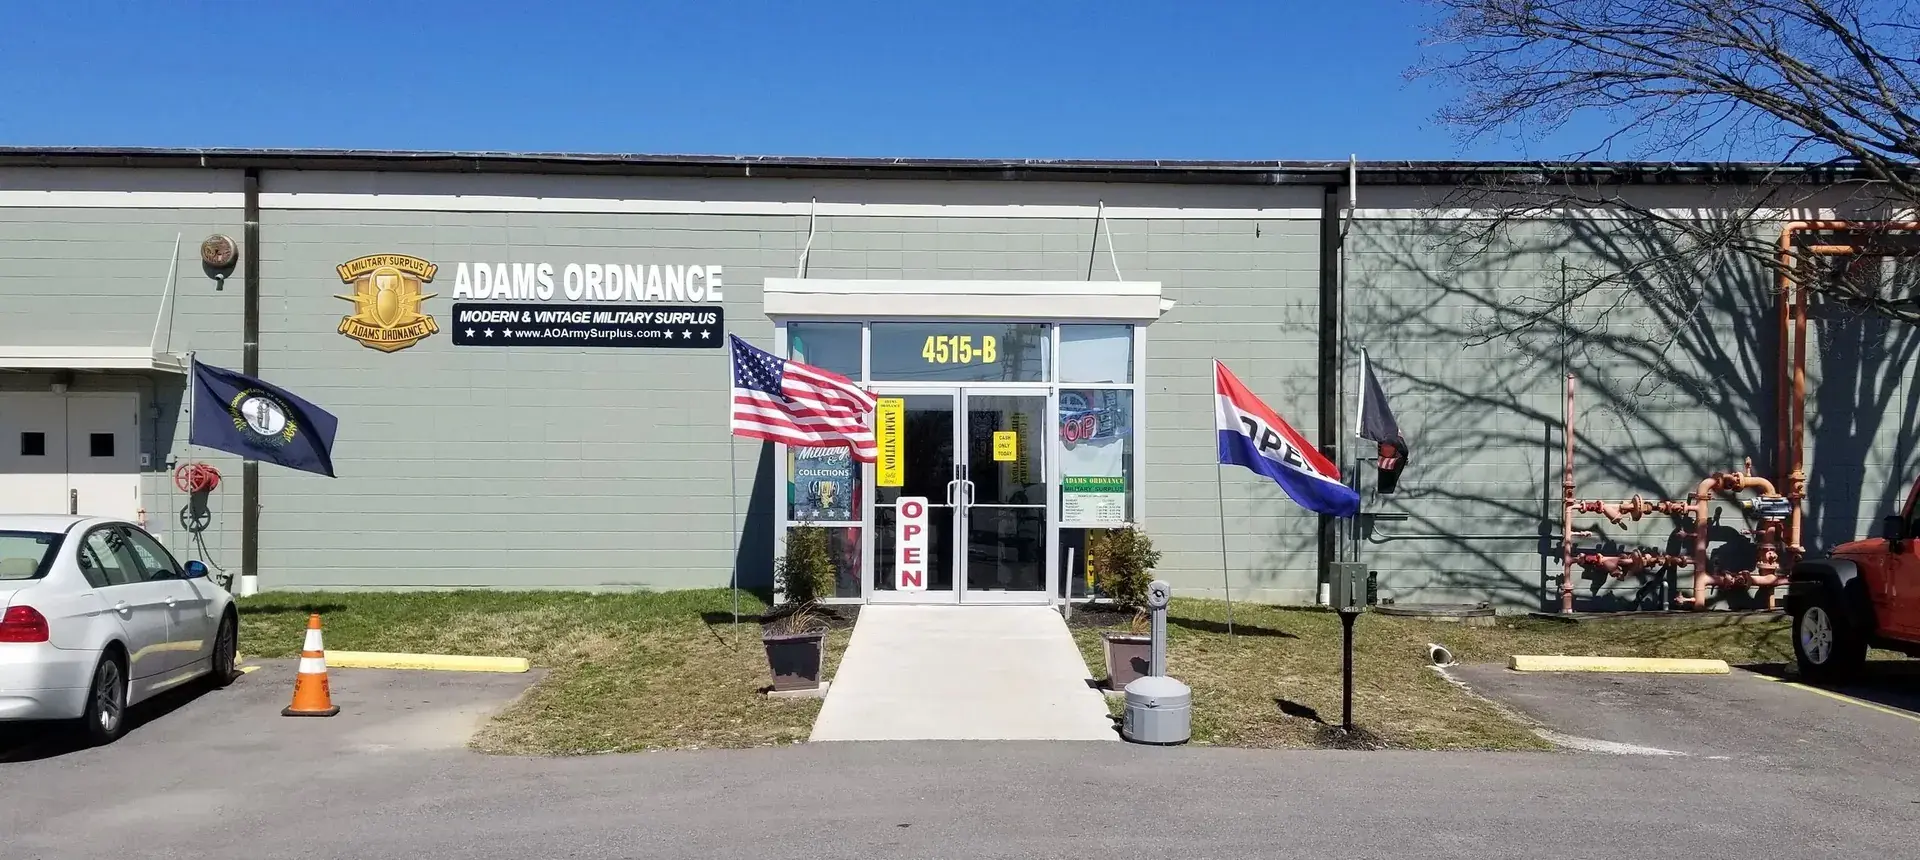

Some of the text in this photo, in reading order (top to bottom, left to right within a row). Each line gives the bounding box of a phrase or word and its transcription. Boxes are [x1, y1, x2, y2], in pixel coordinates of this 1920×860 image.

[351, 257, 424, 272] MILITARY SURPLUS
[452, 262, 723, 302] ADAMS ORDNANCE
[459, 310, 717, 325] MODERN & VINTAGE MILITARY SURPLUS
[351, 324, 424, 340] ADAMS ORDNANCE
[515, 327, 661, 340] www.AOArmySurplus.com
[922, 335, 997, 364] 4515-B
[885, 410, 896, 470] AMMUNITION
[798, 469, 849, 477] COLLECTIONS
[901, 501, 923, 587] OPEN
